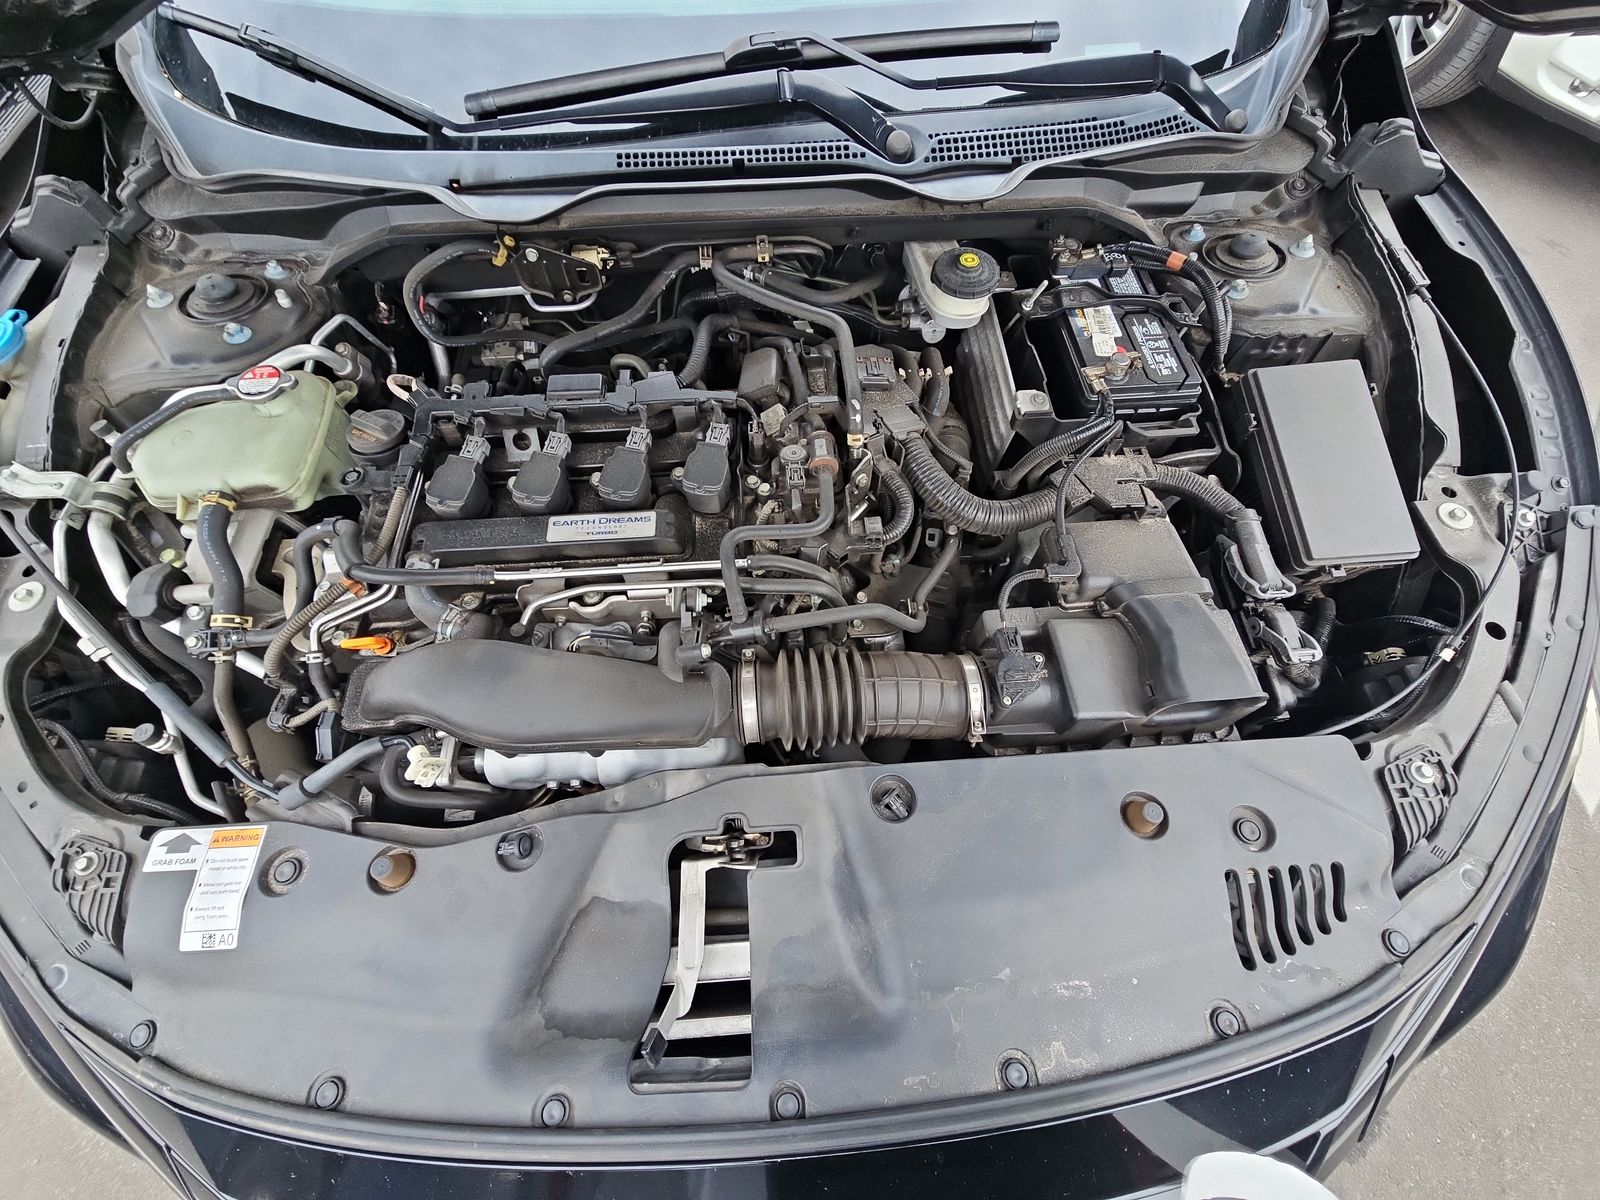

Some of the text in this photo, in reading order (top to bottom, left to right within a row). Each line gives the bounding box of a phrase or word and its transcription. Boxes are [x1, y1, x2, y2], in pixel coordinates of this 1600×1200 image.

[552, 516, 652, 527] EARTH DREAMS
[222, 834, 260, 842] WARNING
[174, 858, 197, 866] FOAM
